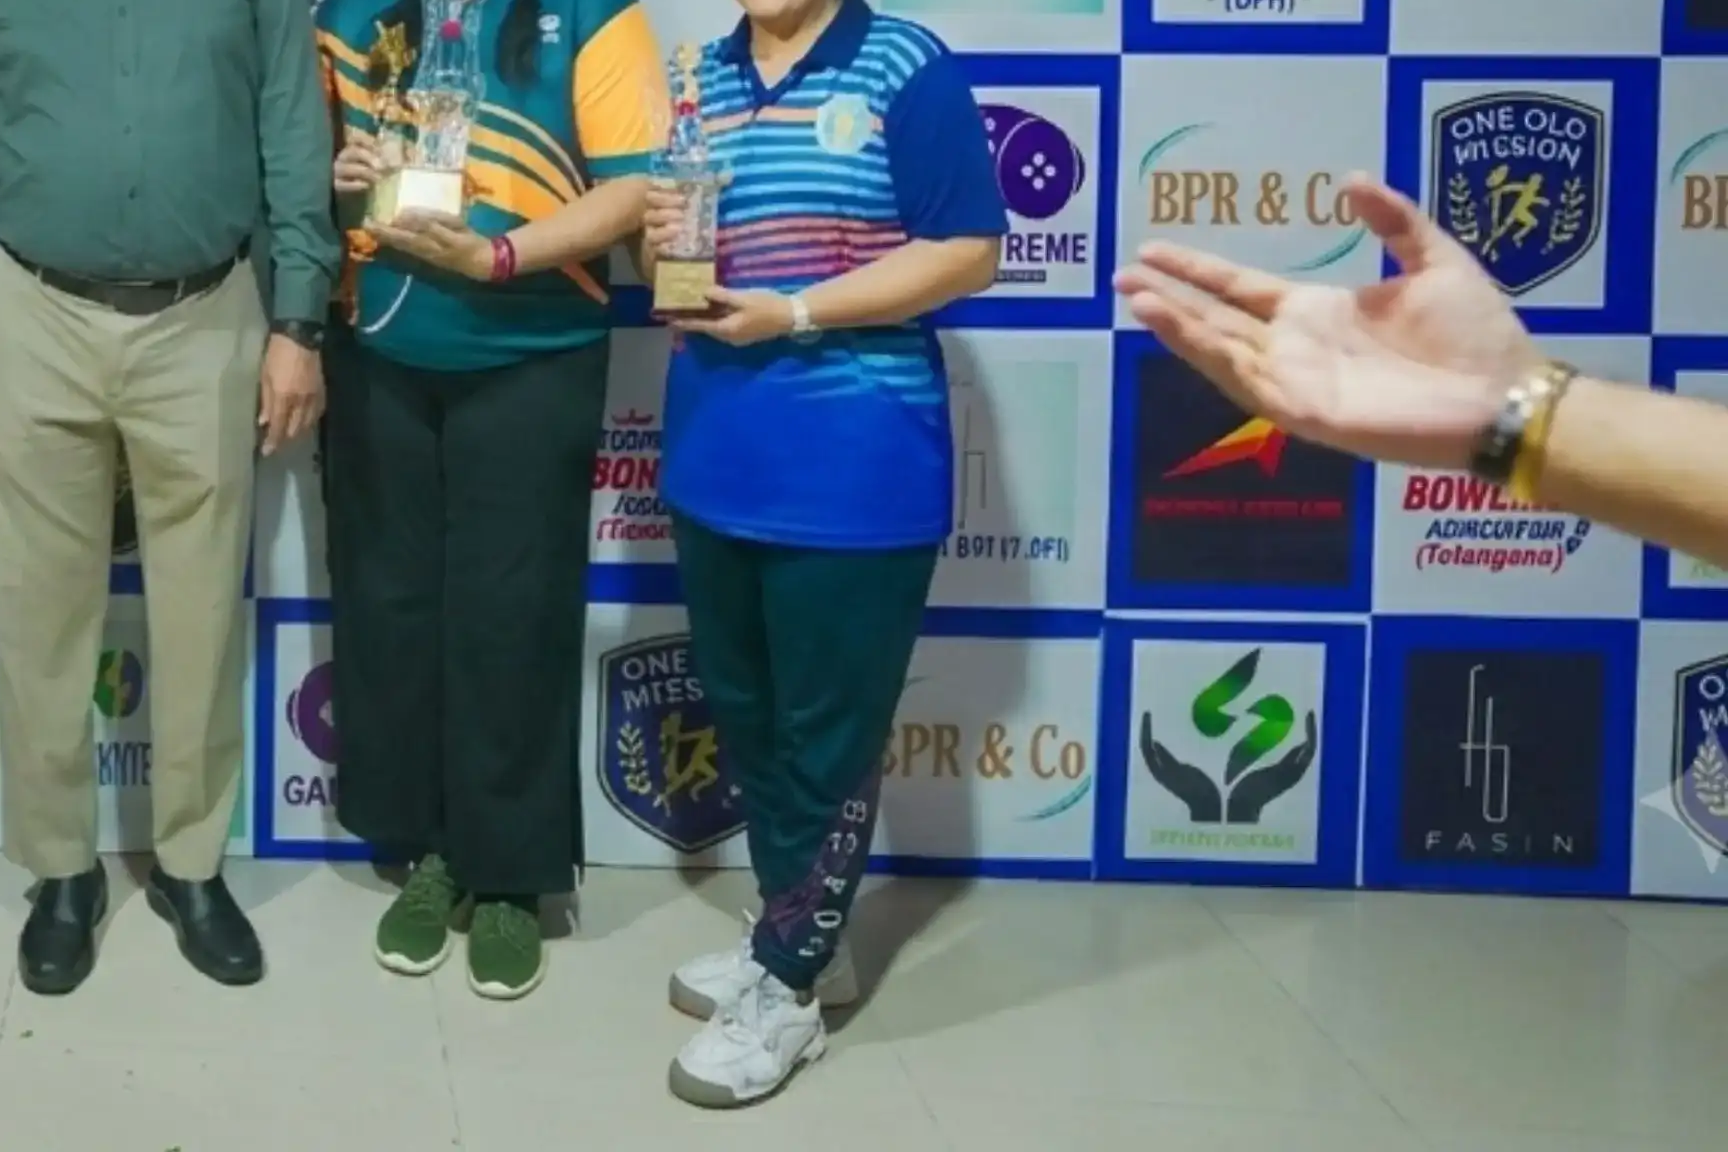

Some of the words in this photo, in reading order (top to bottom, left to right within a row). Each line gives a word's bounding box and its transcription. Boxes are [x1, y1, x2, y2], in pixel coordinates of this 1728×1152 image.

[1451, 106, 1515, 140] ONE
[1149, 172, 1240, 227] BPR
[1255, 172, 1289, 225] &
[1005, 233, 1087, 264] REME
[620, 649, 689, 681] ONE
[976, 723, 1013, 778] &
[1030, 724, 1085, 779] Co
[1425, 830, 1574, 853] FASIN
